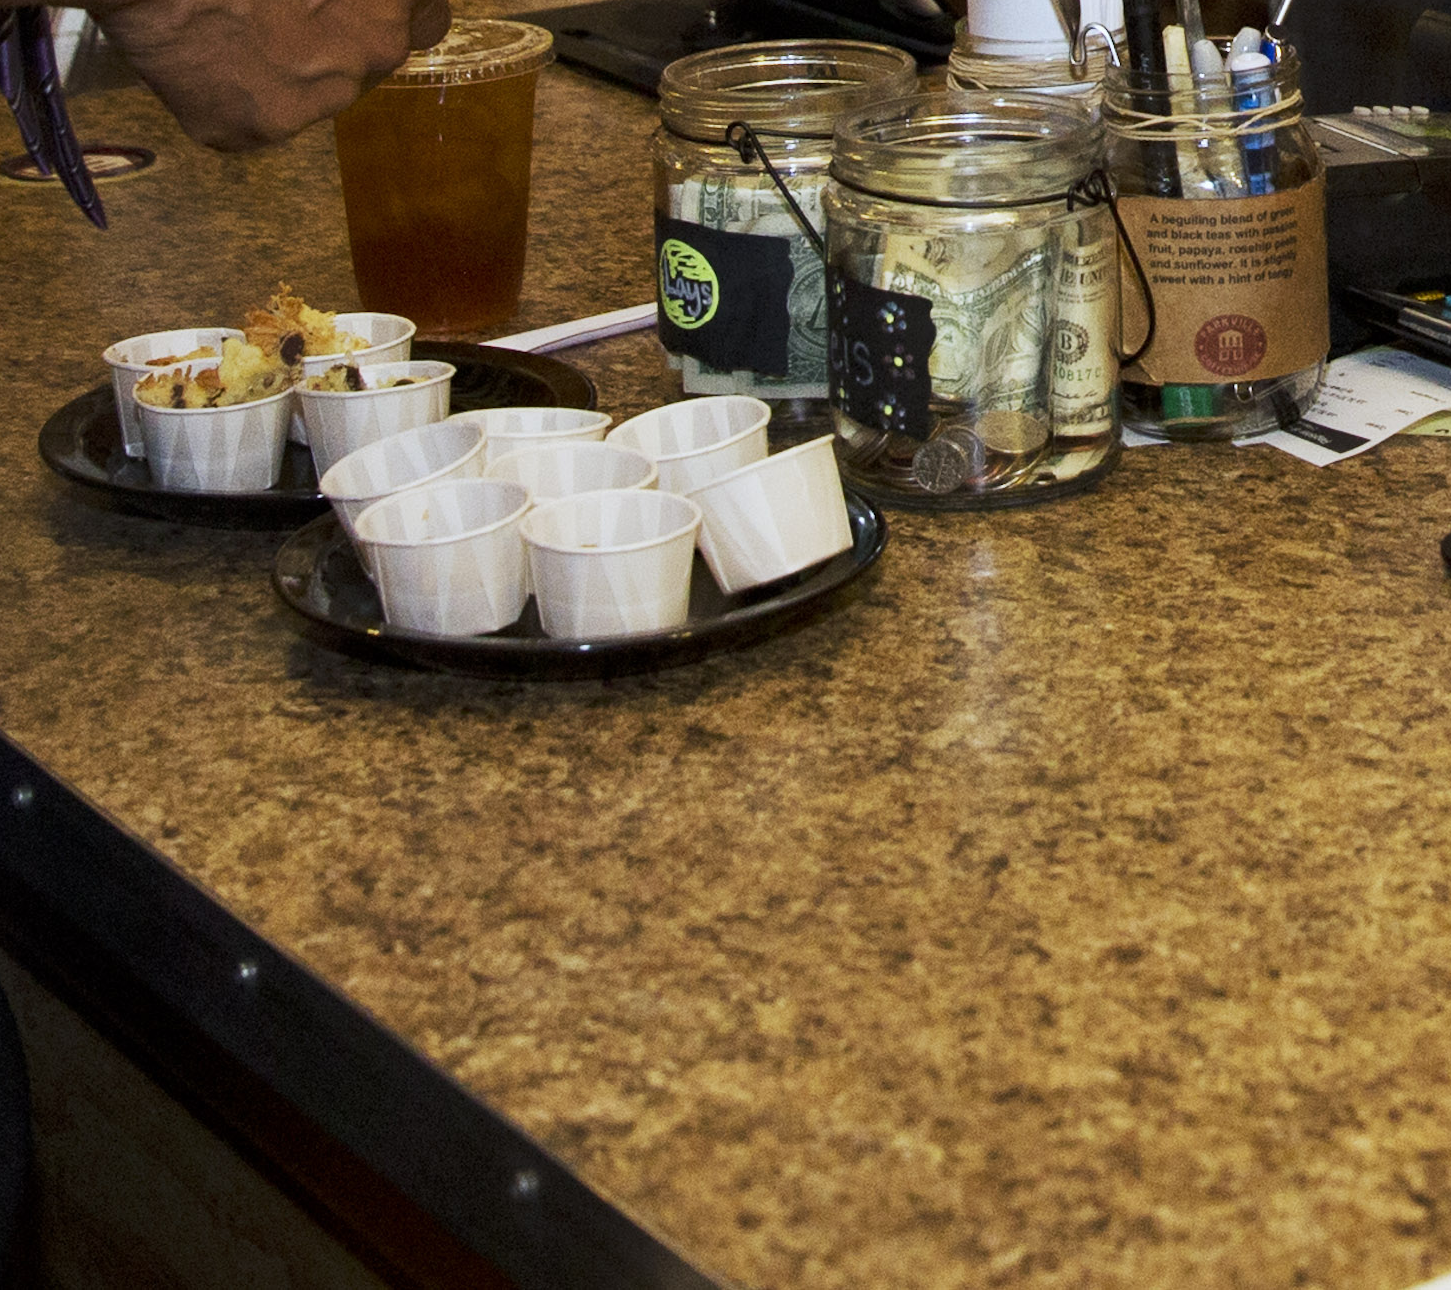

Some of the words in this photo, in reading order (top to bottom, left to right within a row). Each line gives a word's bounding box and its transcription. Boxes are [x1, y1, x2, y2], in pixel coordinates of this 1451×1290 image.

[1151, 213, 1159, 224] A
[1162, 214, 1217, 227] beguiling
[1220, 214, 1254, 226] blend
[1257, 210, 1268, 222] of
[1270, 206, 1296, 219] green
[1147, 229, 1168, 239] and
[1171, 229, 1204, 241] black
[1205, 231, 1232, 241] teas
[1234, 228, 1260, 239] with
[1262, 221, 1299, 237] passion
[1229, 241, 1272, 255] rosehip
[1150, 259, 1172, 270] and
[1240, 257, 1249, 269] It
[1251, 256, 1262, 268] is
[1263, 250, 1298, 265] slightly
[662, 255, 713, 318] Lays
[1152, 274, 1187, 285] sweet
[1189, 273, 1215, 285] with
[1217, 276, 1226, 286] a
[1228, 272, 1253, 285] hint
[1254, 270, 1266, 282] of
